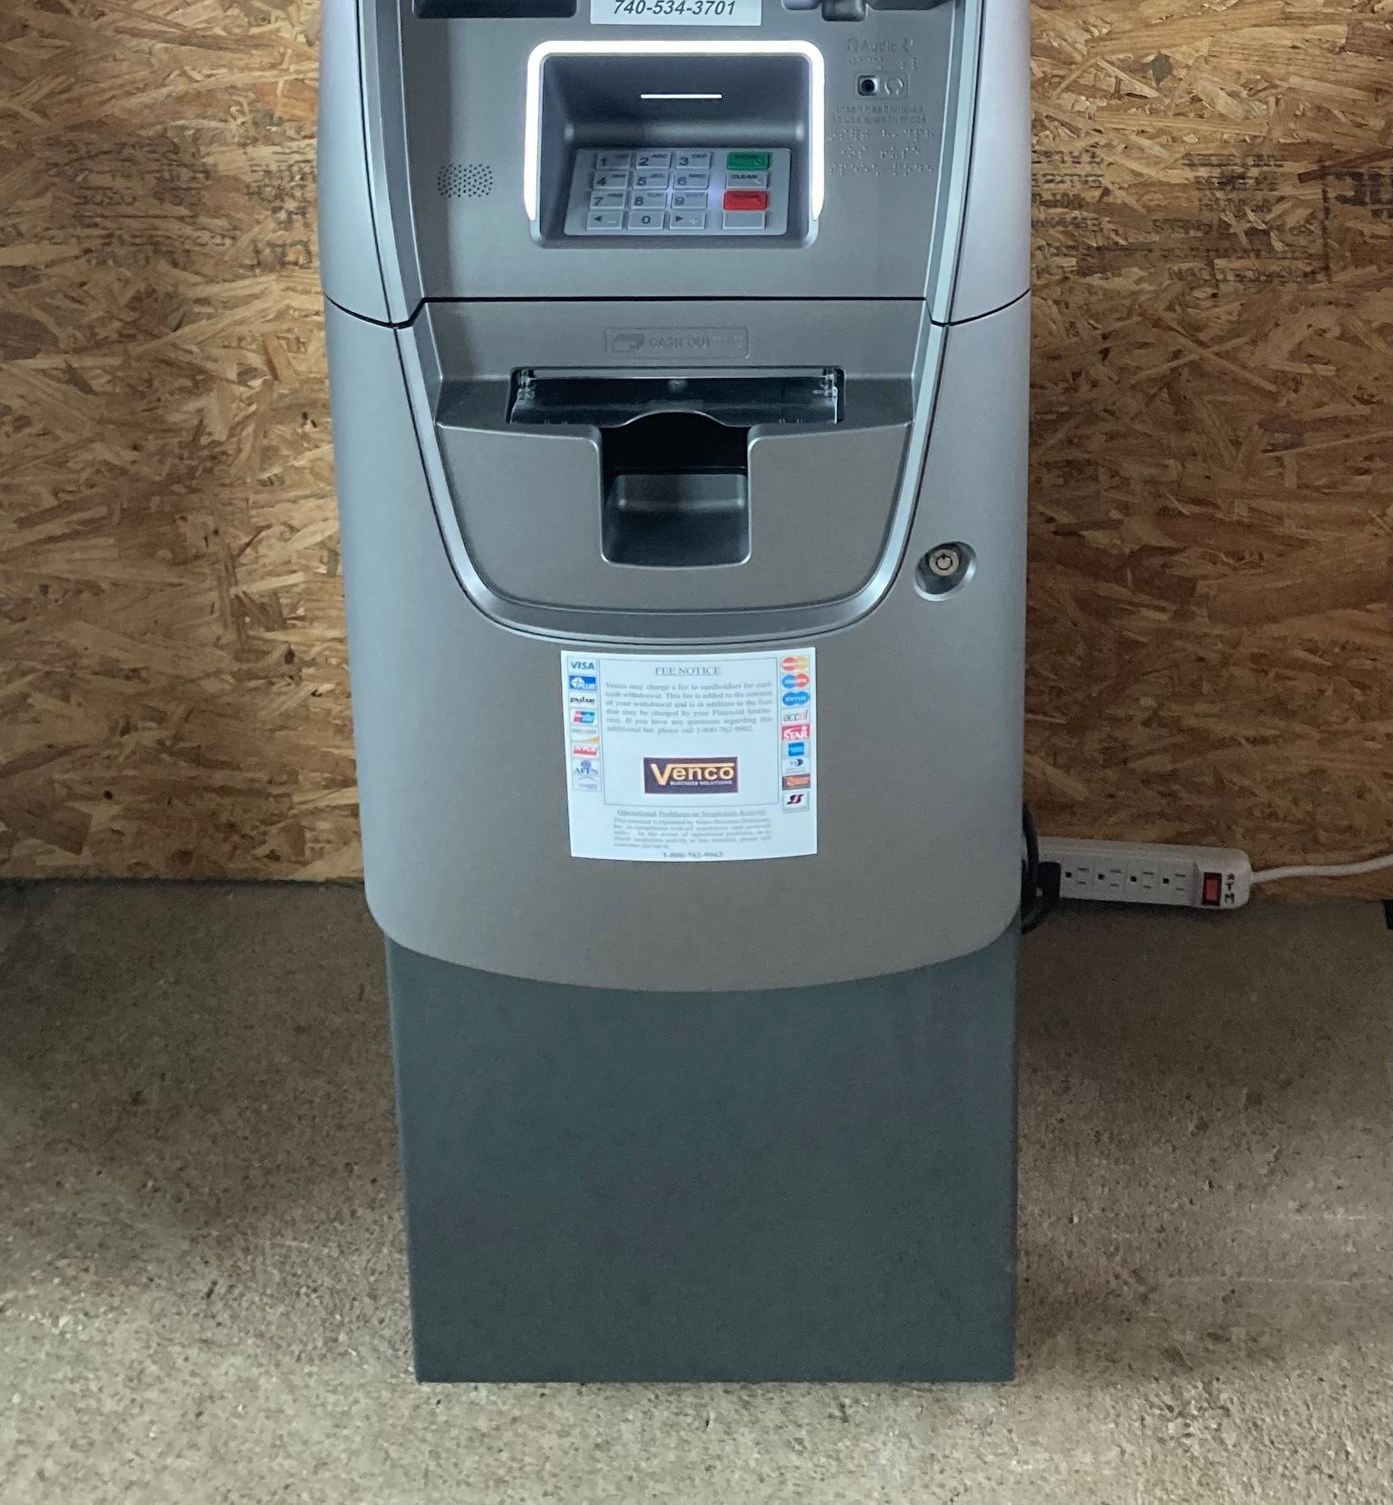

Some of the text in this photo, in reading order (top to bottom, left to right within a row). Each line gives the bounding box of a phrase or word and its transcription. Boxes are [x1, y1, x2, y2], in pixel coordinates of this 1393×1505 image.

[613, 0, 736, 16] 740-534-3701
[601, 157, 607, 166] 1
[639, 157, 649, 166] 2
[679, 157, 689, 166] 3
[596, 177, 607, 186] 4
[637, 177, 647, 186] 5
[677, 177, 687, 185] 6
[593, 197, 604, 206] 7
[634, 197, 644, 206] 8
[674, 197, 684, 206] 9
[571, 661, 595, 670] VISA
[679, 667, 721, 675] NOTICE
[570, 696, 595, 704] pulse
[783, 730, 808, 740] STAR
[650, 762, 735, 786] Venco
